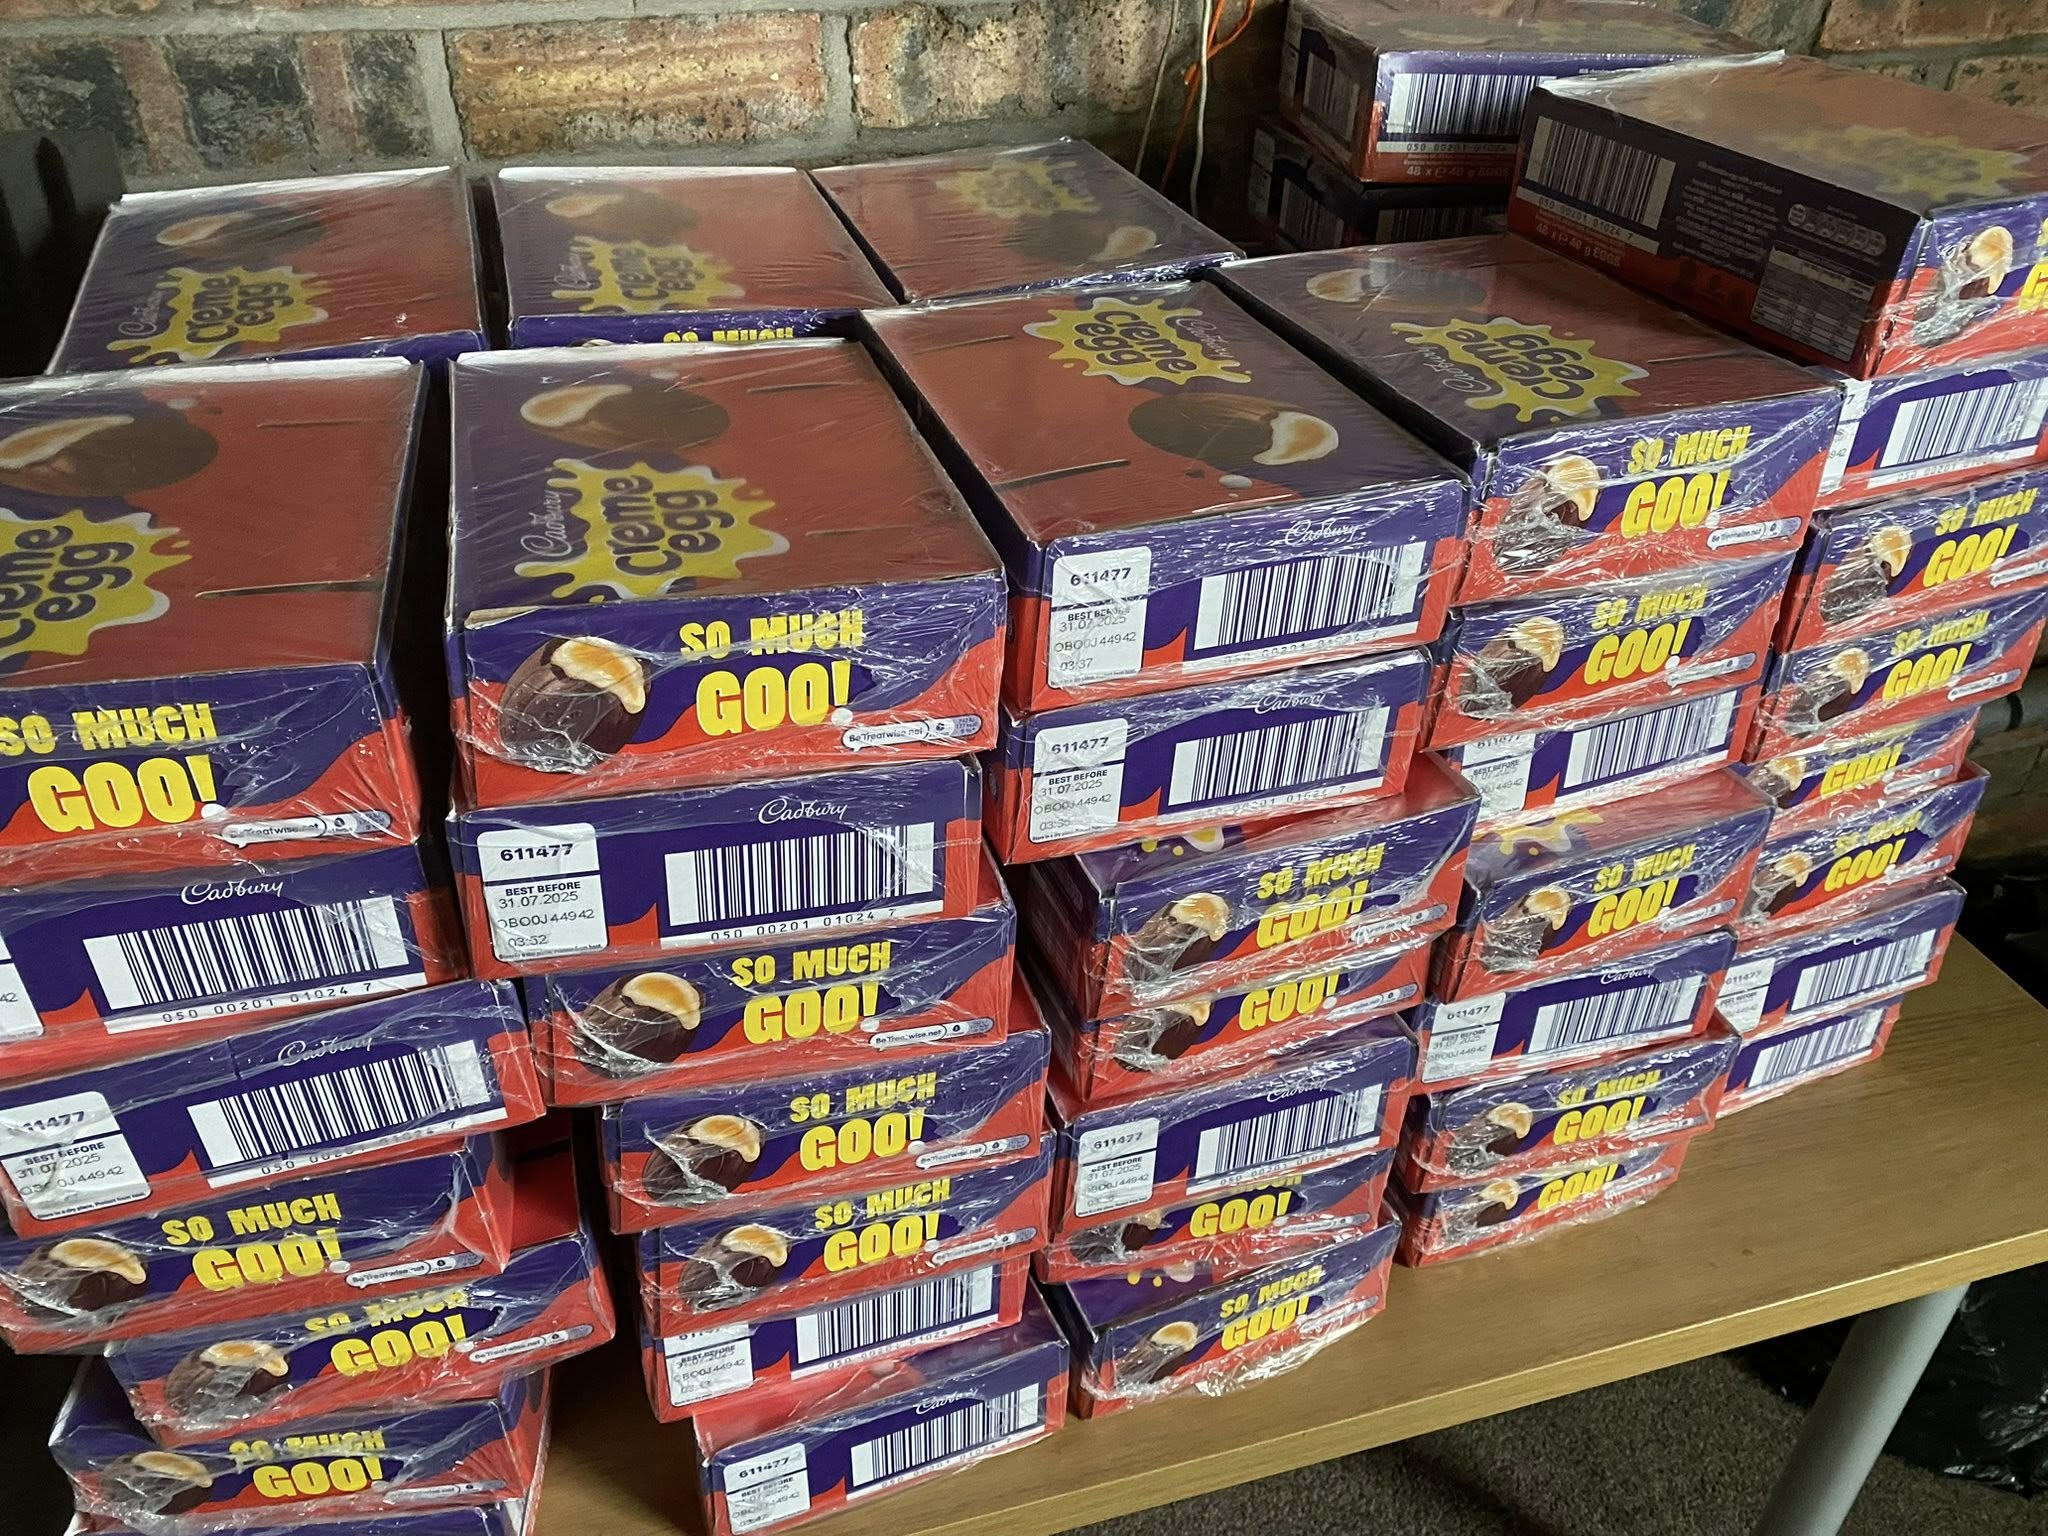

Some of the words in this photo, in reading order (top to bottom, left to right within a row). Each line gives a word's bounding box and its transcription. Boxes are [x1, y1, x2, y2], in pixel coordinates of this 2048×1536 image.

[233, 281, 296, 331] egg
[1074, 322, 1152, 367] egg
[1095, 310, 1199, 375] Creme
[1445, 327, 1586, 401] Creme
[1498, 332, 1596, 383] egg
[1627, 438, 1664, 475] SO
[1671, 425, 1752, 469] MUCH
[521, 490, 574, 556] Cadbury
[601, 475, 683, 576] Creme
[653, 489, 756, 553] egg
[1621, 469, 1734, 540] GOO!
[1935, 506, 1969, 536] SO
[1969, 487, 2039, 527] MUCH
[1285, 519, 1361, 546] Cadbury
[1922, 523, 2019, 588] GOO!
[34, 541, 135, 622] egg
[1070, 567, 1132, 587] 611477
[1068, 611, 1091, 621] BEST
[1592, 598, 1628, 630] SO
[1634, 580, 1710, 623] MUCH
[680, 620, 731, 660] SO
[750, 608, 865, 657] MUCH
[1584, 618, 1694, 685] GOO!
[1891, 629, 1922, 657] SO
[1926, 610, 1992, 645] MUCH
[696, 659, 854, 737] GOO!
[1882, 643, 1973, 702] GOO!
[1254, 693, 1326, 714] Cadbury
[0, 714, 58, 757] SO
[71, 702, 220, 751] MUCH
[27, 754, 228, 832] GOO!
[1048, 775, 1073, 786] BEST
[1073, 769, 1109, 782] BEFORE
[1819, 743, 1905, 800] GOO!
[758, 798, 848, 826] Cadbury
[499, 843, 574, 862] 611477
[1256, 866, 1293, 899] SO
[1303, 842, 1386, 888] MUCH
[1593, 863, 1625, 893] SO
[1630, 843, 1698, 882] MUCH
[1823, 838, 1907, 893] GOO!
[181, 879, 284, 905] Cadbury
[498, 890, 579, 910] 31.07.2025
[505, 886, 535, 897] BEST
[537, 881, 581, 894] BEFORE
[1256, 879, 1371, 949] GOO!
[1587, 876, 1681, 938] GOO!
[711, 929, 744, 942] 050
[756, 920, 810, 936] 00201
[823, 912, 876, 928] 01024
[888, 907, 897, 918] 7
[731, 955, 776, 988] SO
[793, 940, 893, 981] MUCH
[1600, 966, 1656, 985] Cadbury
[162, 1008, 199, 1023] 050
[213, 996, 275, 1016] 00201
[290, 985, 349, 1004] 01024
[363, 981, 373, 992] 7
[743, 981, 881, 1045] GOO!
[1238, 971, 1341, 1032] GOO!
[278, 1037, 374, 1067] Cadbury
[790, 1094, 830, 1123] SO
[845, 1072, 937, 1114] MUCH
[1594, 1069, 1662, 1100] MUCH
[800, 1107, 926, 1171] GOO!
[1094, 1132, 1143, 1150] 611477
[1554, 1095, 1647, 1146] GOO!
[24, 1152, 56, 1166] BEST
[57, 1141, 106, 1159] BEFORE
[262, 1160, 295, 1176] 050
[447, 1120, 457, 1130] 7
[1112, 1156, 1142, 1168] BEFORE
[814, 1201, 853, 1230] SO
[866, 1177, 951, 1219] MUCH
[1538, 1162, 1620, 1211] GOO!
[161, 1215, 214, 1246] SO
[227, 1192, 343, 1237] MUCH
[1190, 1190, 1293, 1238] GOO!
[192, 1227, 352, 1292] GOO!
[824, 1211, 940, 1272] GOO!
[1220, 1293, 1248, 1319] SO
[1258, 1265, 1323, 1305] MUCH
[331, 1314, 475, 1376] GOO!
[253, 1456, 391, 1498] GOO!
[739, 1457, 790, 1479] 611477
